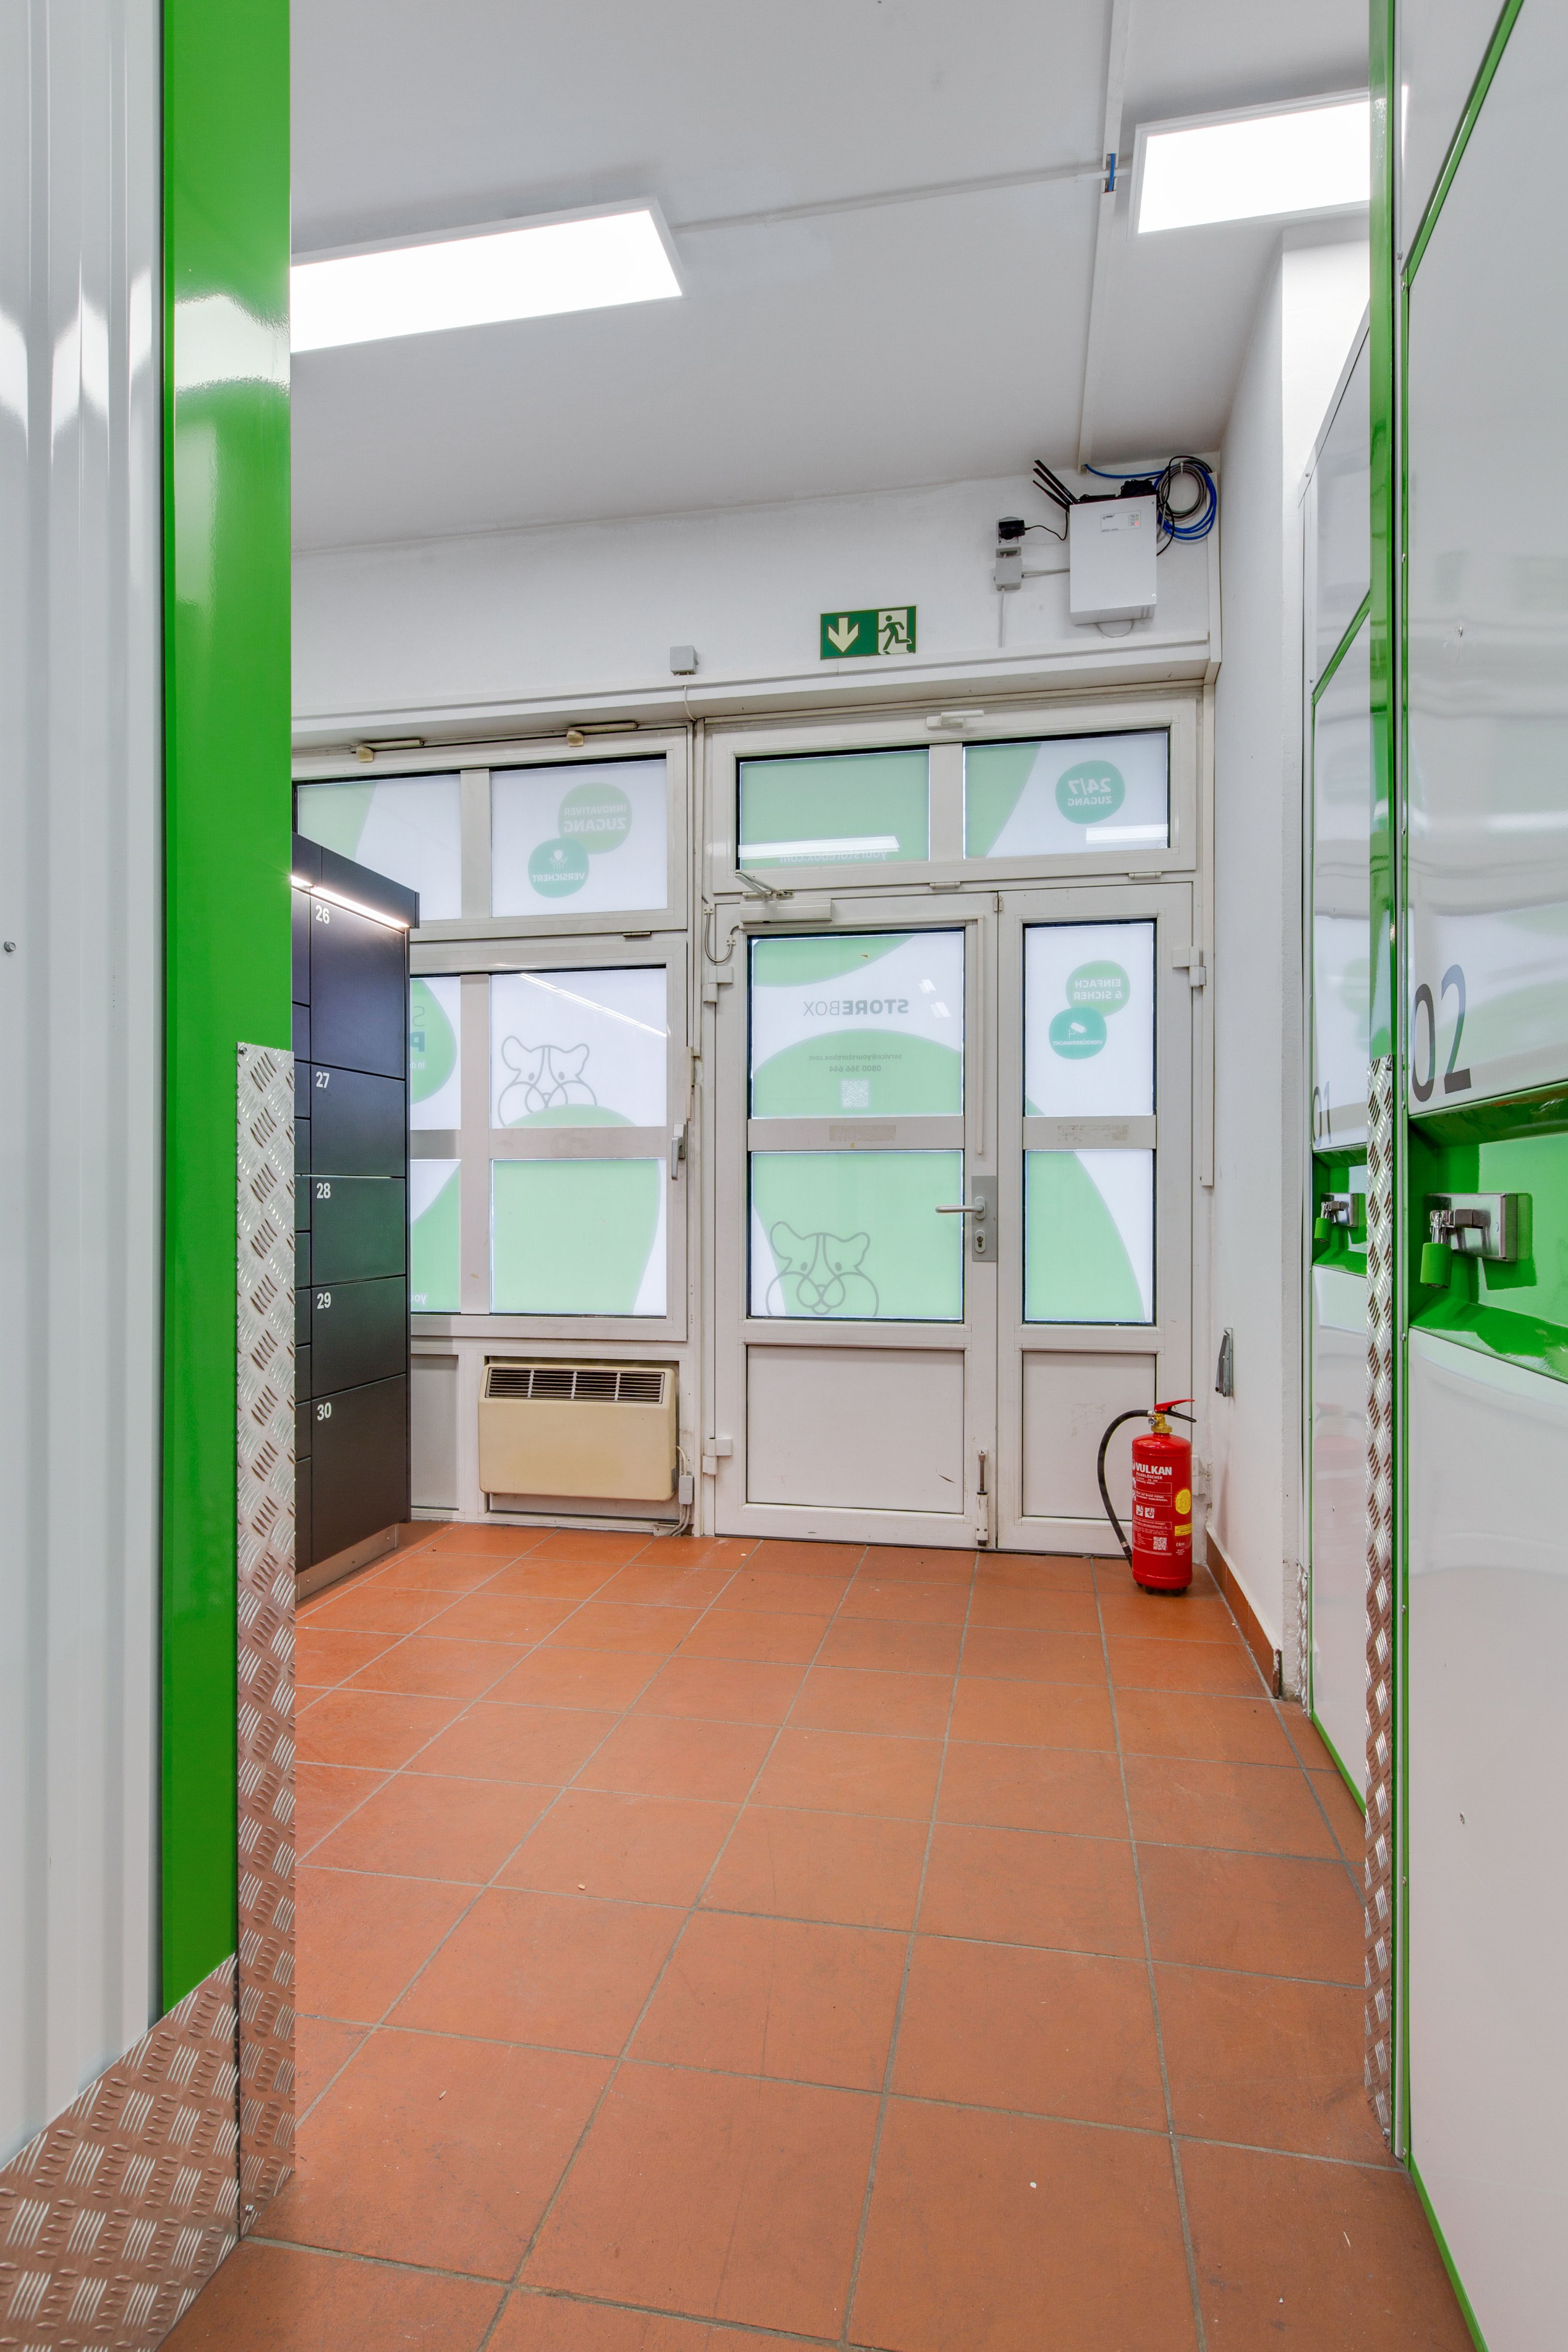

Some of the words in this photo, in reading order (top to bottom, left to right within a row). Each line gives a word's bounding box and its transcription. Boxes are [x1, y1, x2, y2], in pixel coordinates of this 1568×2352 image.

[316, 905, 330, 924] 26
[1410, 964, 1472, 1102] 02
[316, 1071, 330, 1088] 27
[1313, 1081, 1332, 1148] 01
[316, 1182, 331, 1199] 28
[317, 1292, 332, 1310] 29
[317, 1402, 332, 1421] 30
[1135, 1462, 1172, 1476] VULKAN
[1136, 1472, 1162, 1480] FEUERLÖSCHER
